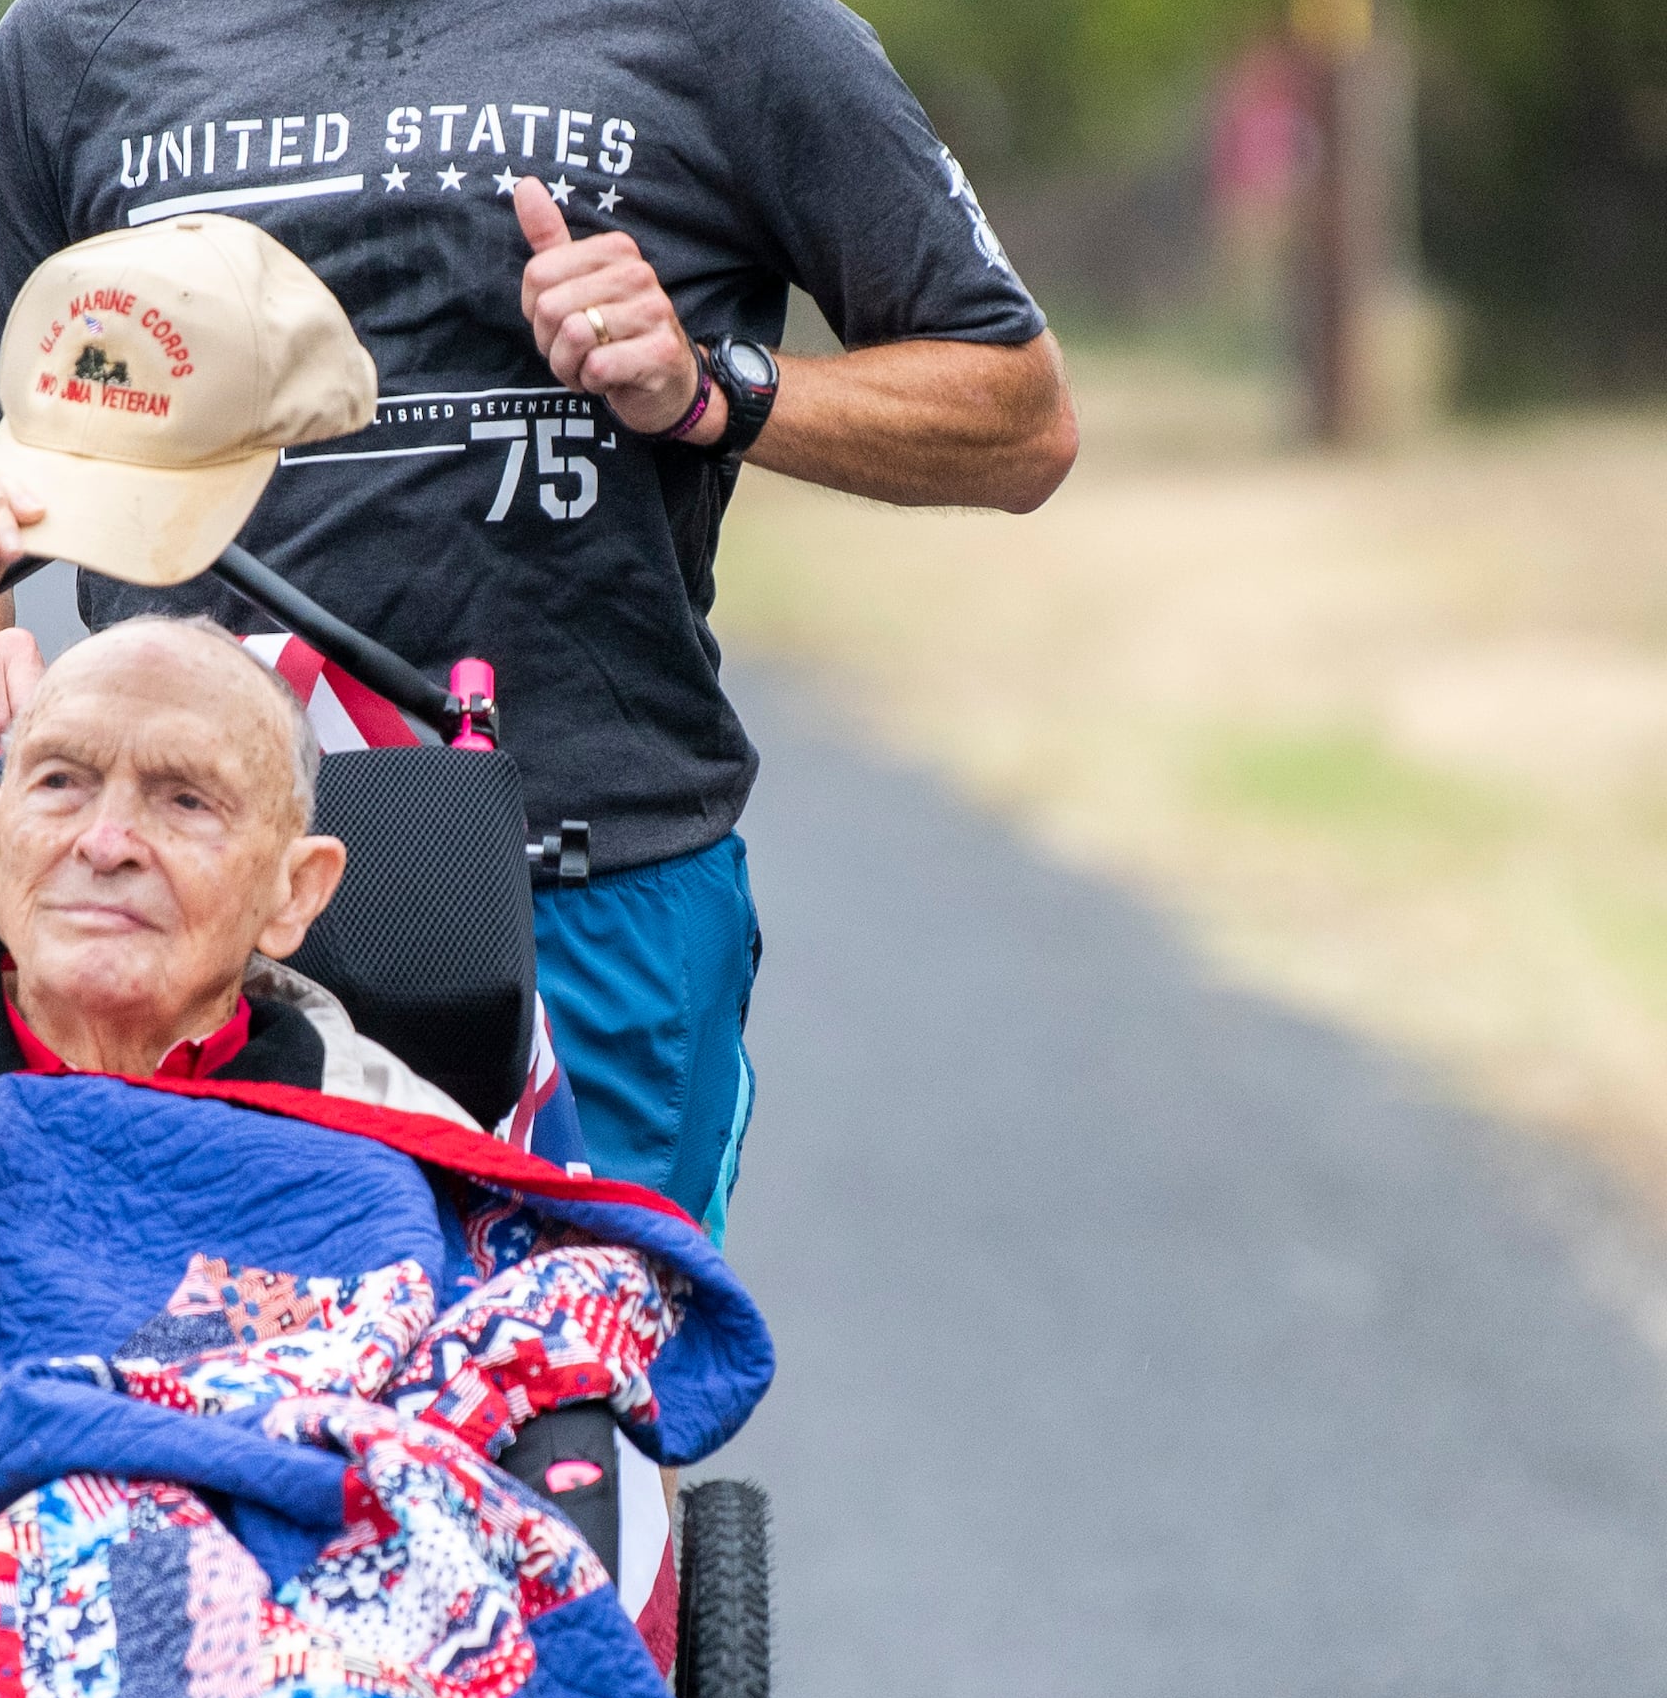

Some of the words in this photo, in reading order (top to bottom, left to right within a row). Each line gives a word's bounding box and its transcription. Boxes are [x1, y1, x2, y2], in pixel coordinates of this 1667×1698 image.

[120, 112, 350, 190] UNITED
[383, 103, 637, 177] STATES
[70, 289, 137, 319] MARINE
[141, 307, 194, 379] CORPS
[101, 383, 171, 418] VETERAN
[373, 403, 455, 426] LISHED
[471, 398, 592, 417] SEVENTEEN
[470, 418, 599, 521] 75
